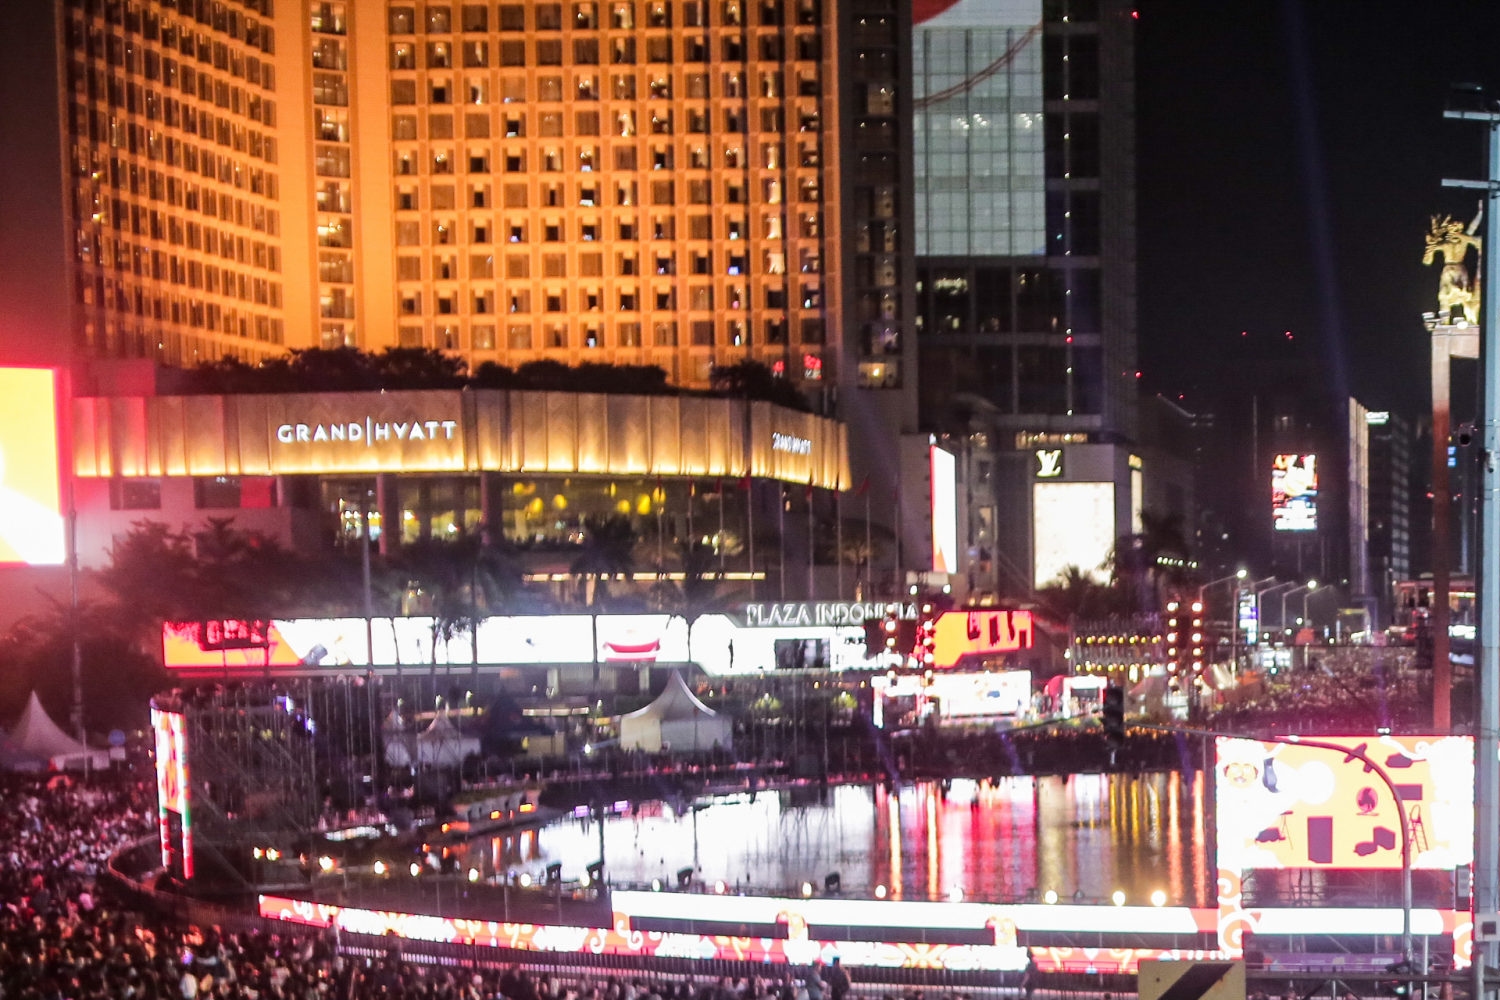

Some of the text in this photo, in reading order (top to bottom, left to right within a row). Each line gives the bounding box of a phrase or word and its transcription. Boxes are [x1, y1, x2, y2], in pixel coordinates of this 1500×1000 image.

[277, 420, 457, 443] GRAND HYATT
[746, 602, 918, 626] PLAZA INDONIA
